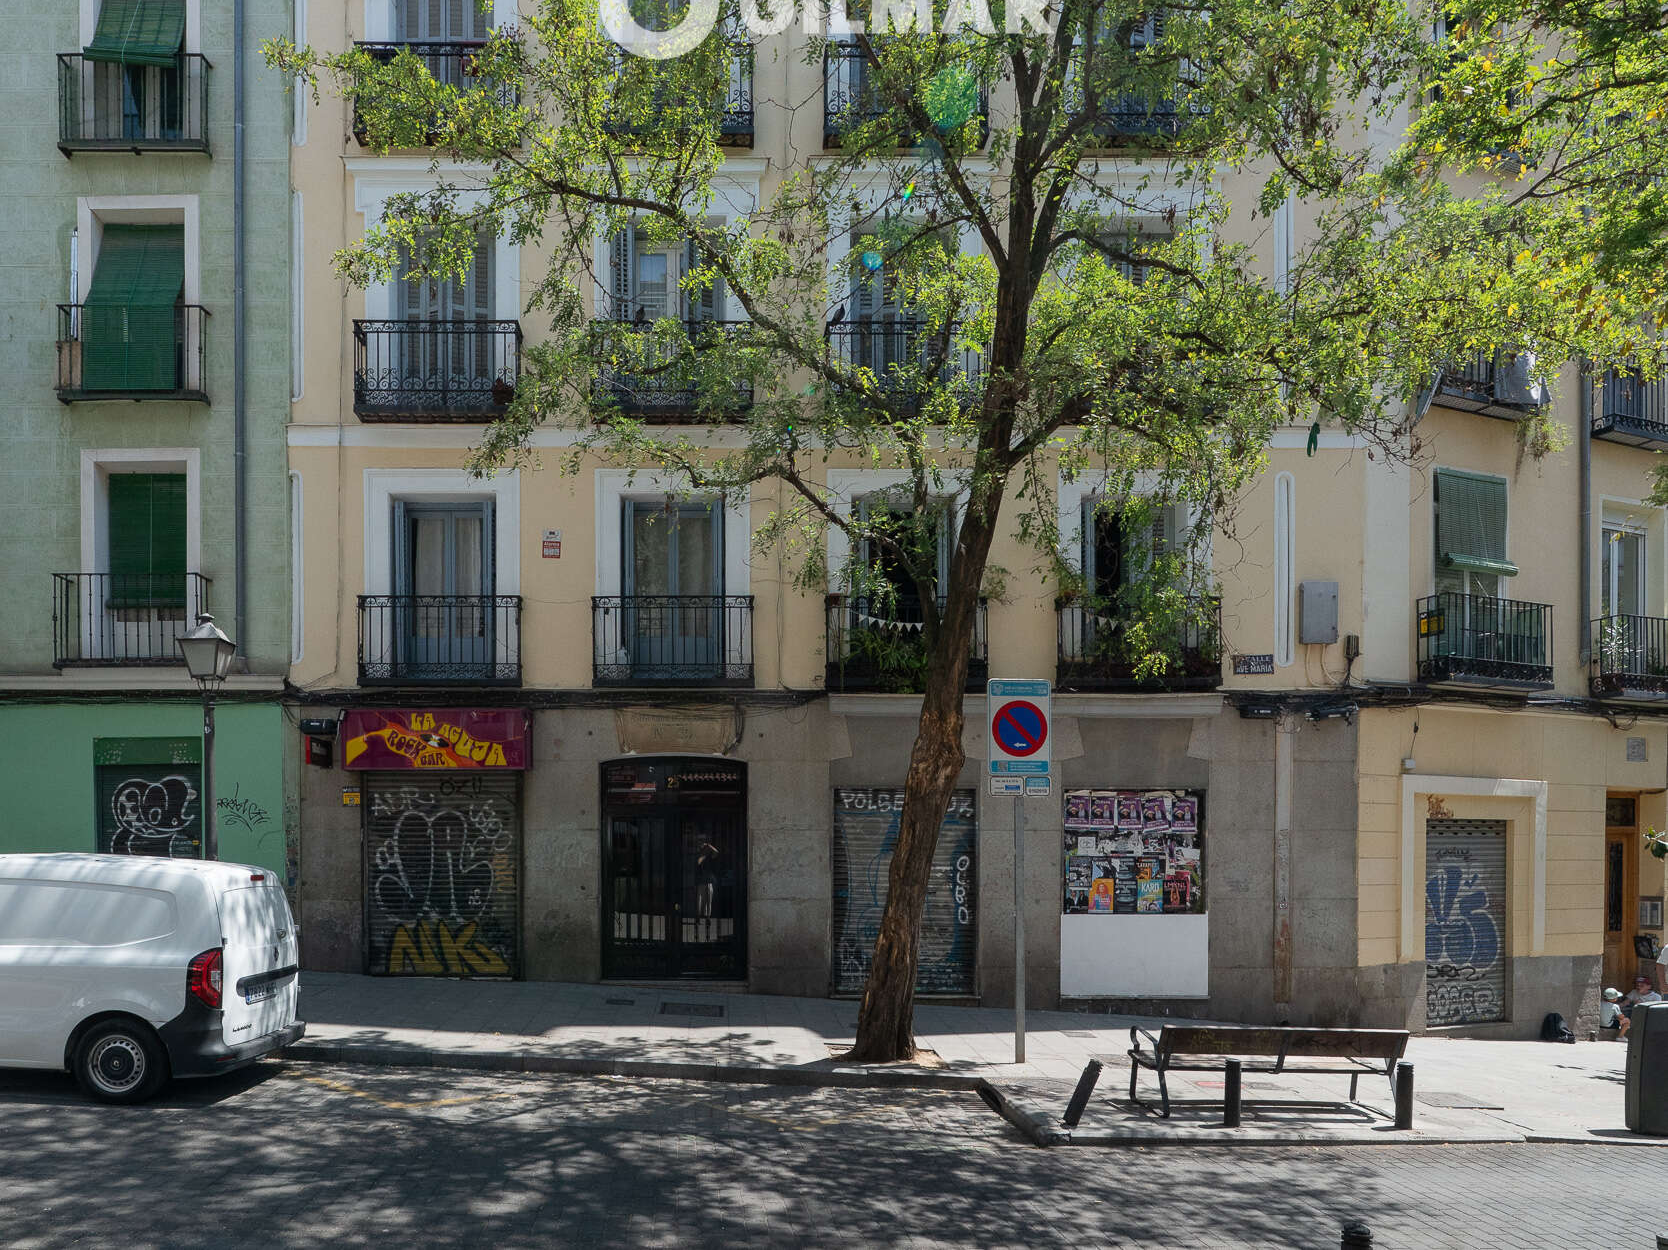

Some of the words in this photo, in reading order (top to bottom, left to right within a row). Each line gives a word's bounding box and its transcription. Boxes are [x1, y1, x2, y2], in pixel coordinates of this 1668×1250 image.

[411, 712, 436, 731] LA
[387, 729, 427, 760] ROCK
[438, 723, 507, 766] AGUJA
[420, 752, 446, 767] BAR
